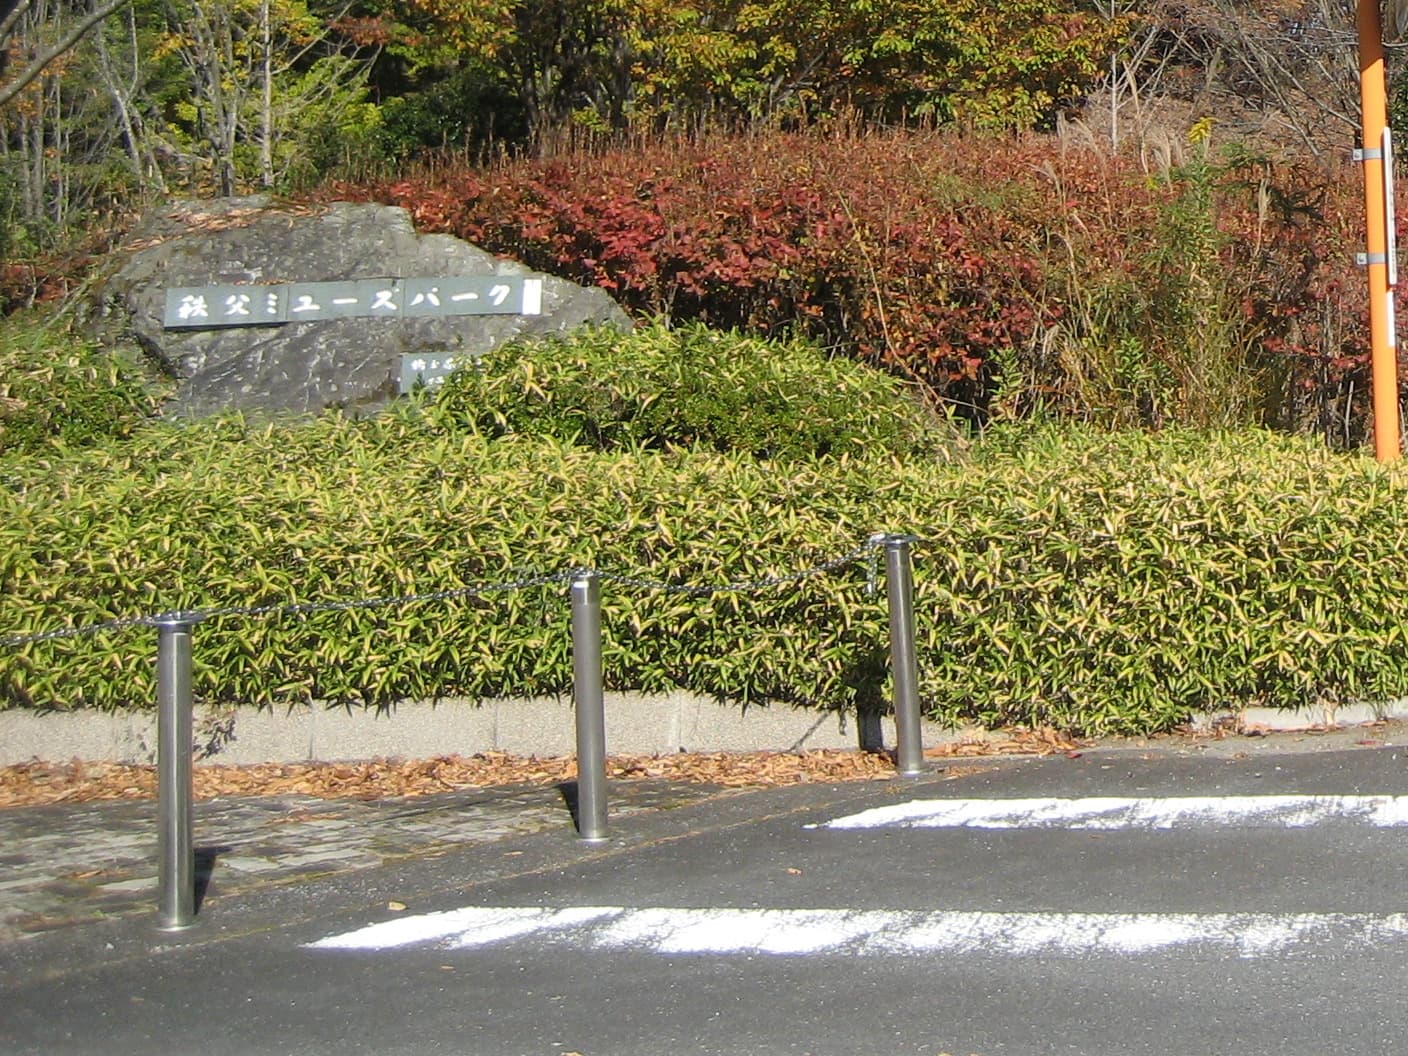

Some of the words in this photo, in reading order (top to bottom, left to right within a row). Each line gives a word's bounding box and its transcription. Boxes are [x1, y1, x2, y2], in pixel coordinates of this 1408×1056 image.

[178, 284, 511, 319] 秩父ミューズパーク
